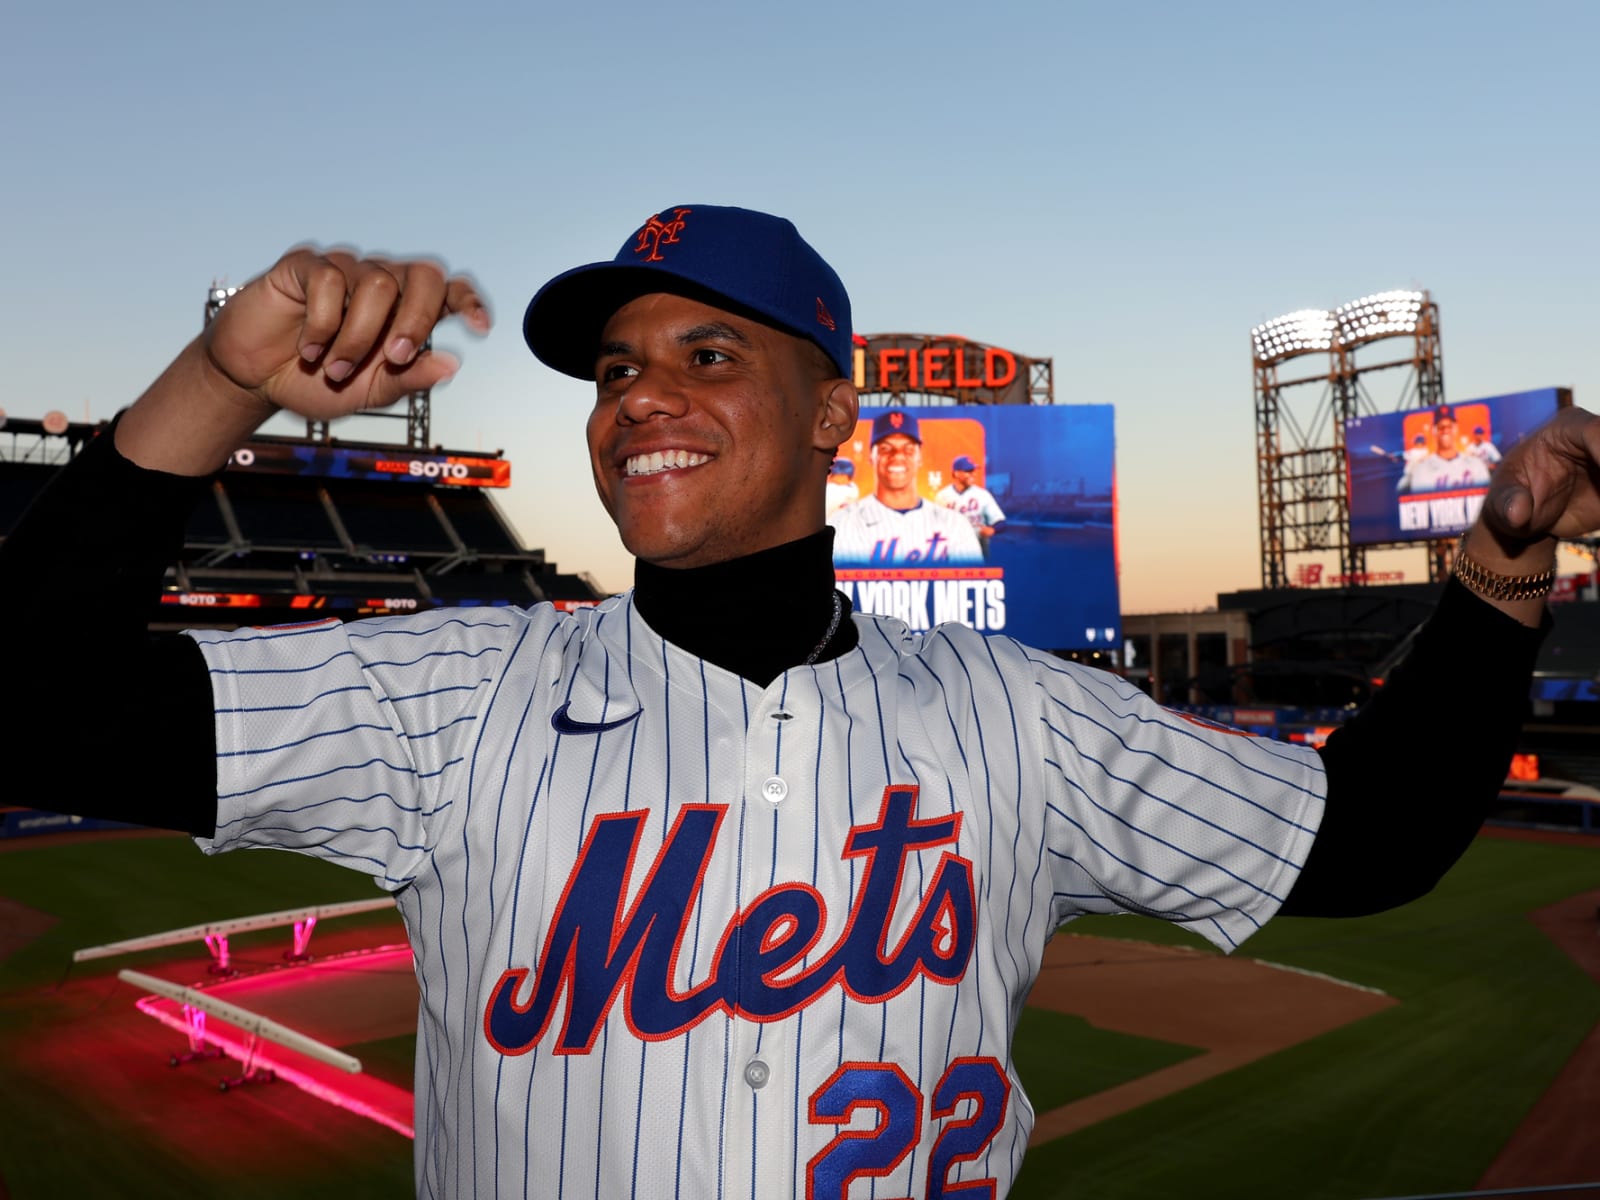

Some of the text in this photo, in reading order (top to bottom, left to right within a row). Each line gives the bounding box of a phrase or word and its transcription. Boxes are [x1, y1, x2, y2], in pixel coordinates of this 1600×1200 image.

[879, 347, 1017, 388] FIELD
[408, 460, 468, 478] SOTO
[180, 594, 216, 605] SOTO
[384, 598, 417, 609] SOTO
[856, 579, 1006, 631] YORK METS
[484, 784, 976, 1056] Mets
[806, 1056, 1011, 1200] 22
